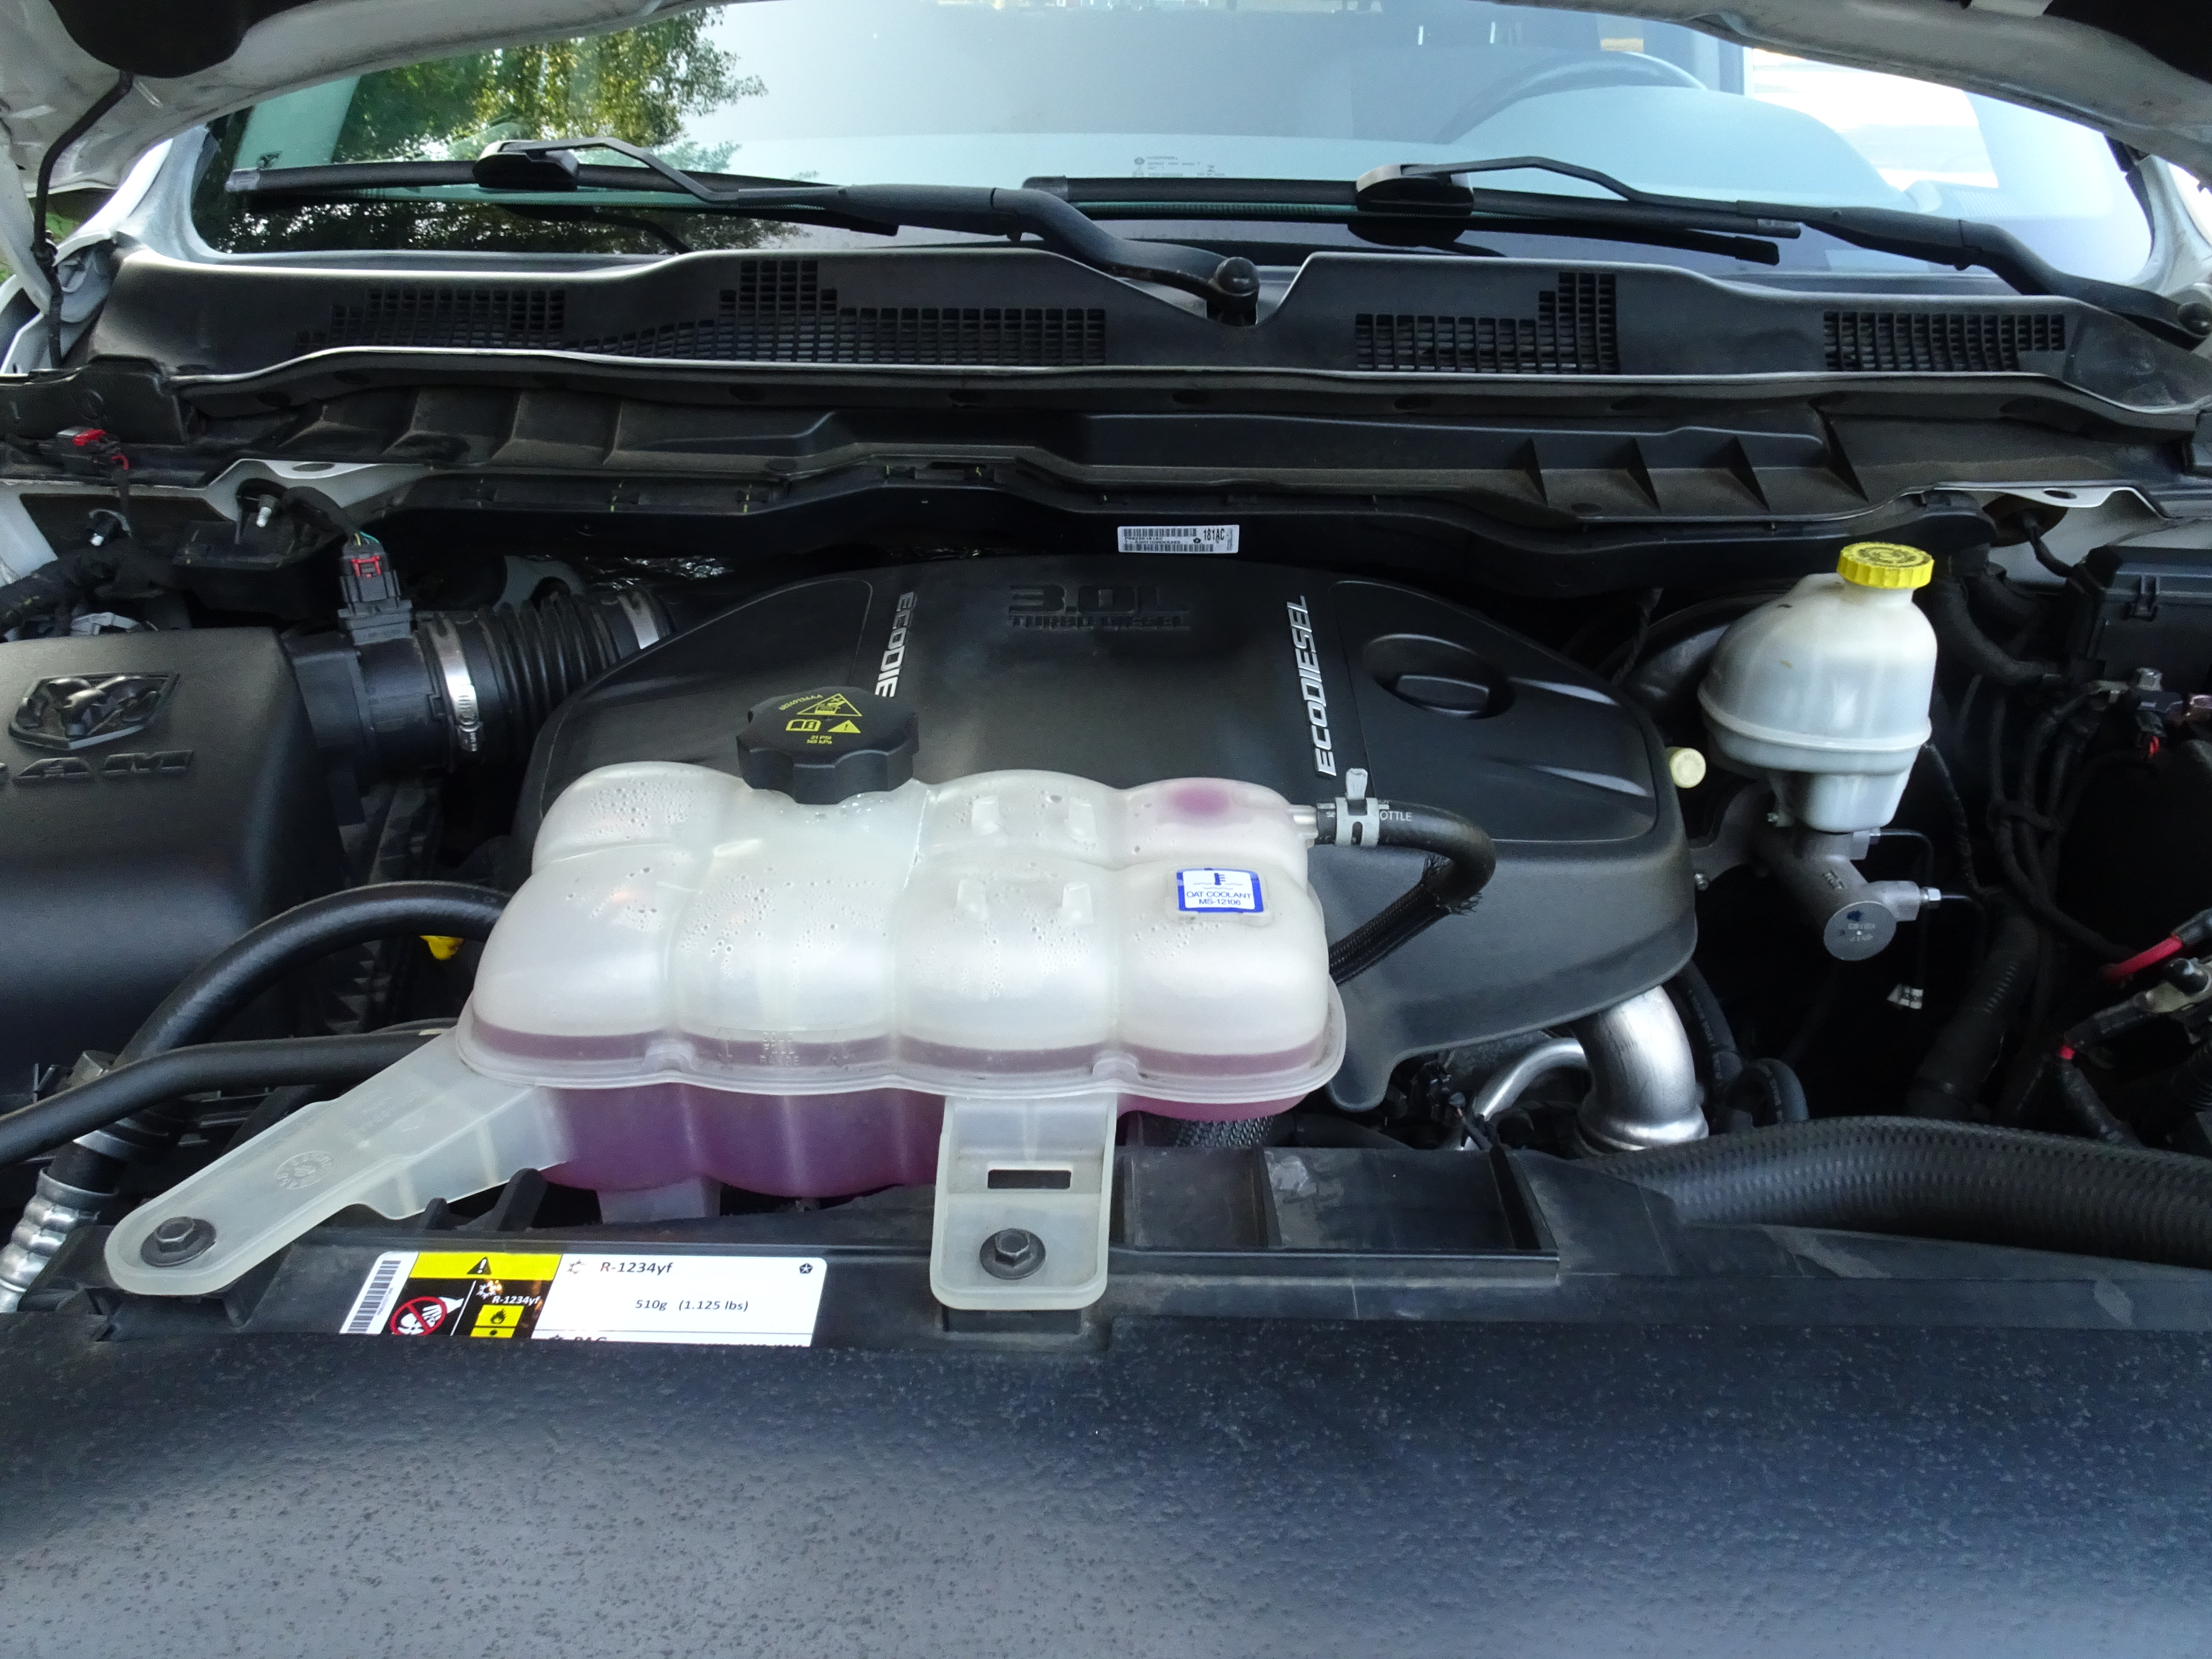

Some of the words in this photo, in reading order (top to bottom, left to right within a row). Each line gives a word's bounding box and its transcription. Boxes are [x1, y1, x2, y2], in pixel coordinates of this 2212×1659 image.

[1203, 528, 1225, 541] 181AC
[874, 591, 914, 698] ECODIE
[1287, 595, 1336, 776] ECODIESEL
[0, 750, 193, 778] AM
[1380, 811, 1413, 821] OTTLE
[1206, 891, 1252, 899] COOLANT
[600, 1262, 674, 1275] R-1234yf
[492, 1295, 541, 1306] R-1234yf
[635, 1299, 668, 1311] 510g
[678, 1299, 721, 1311] (1.125
[725, 1300, 749, 1312] lbs)
